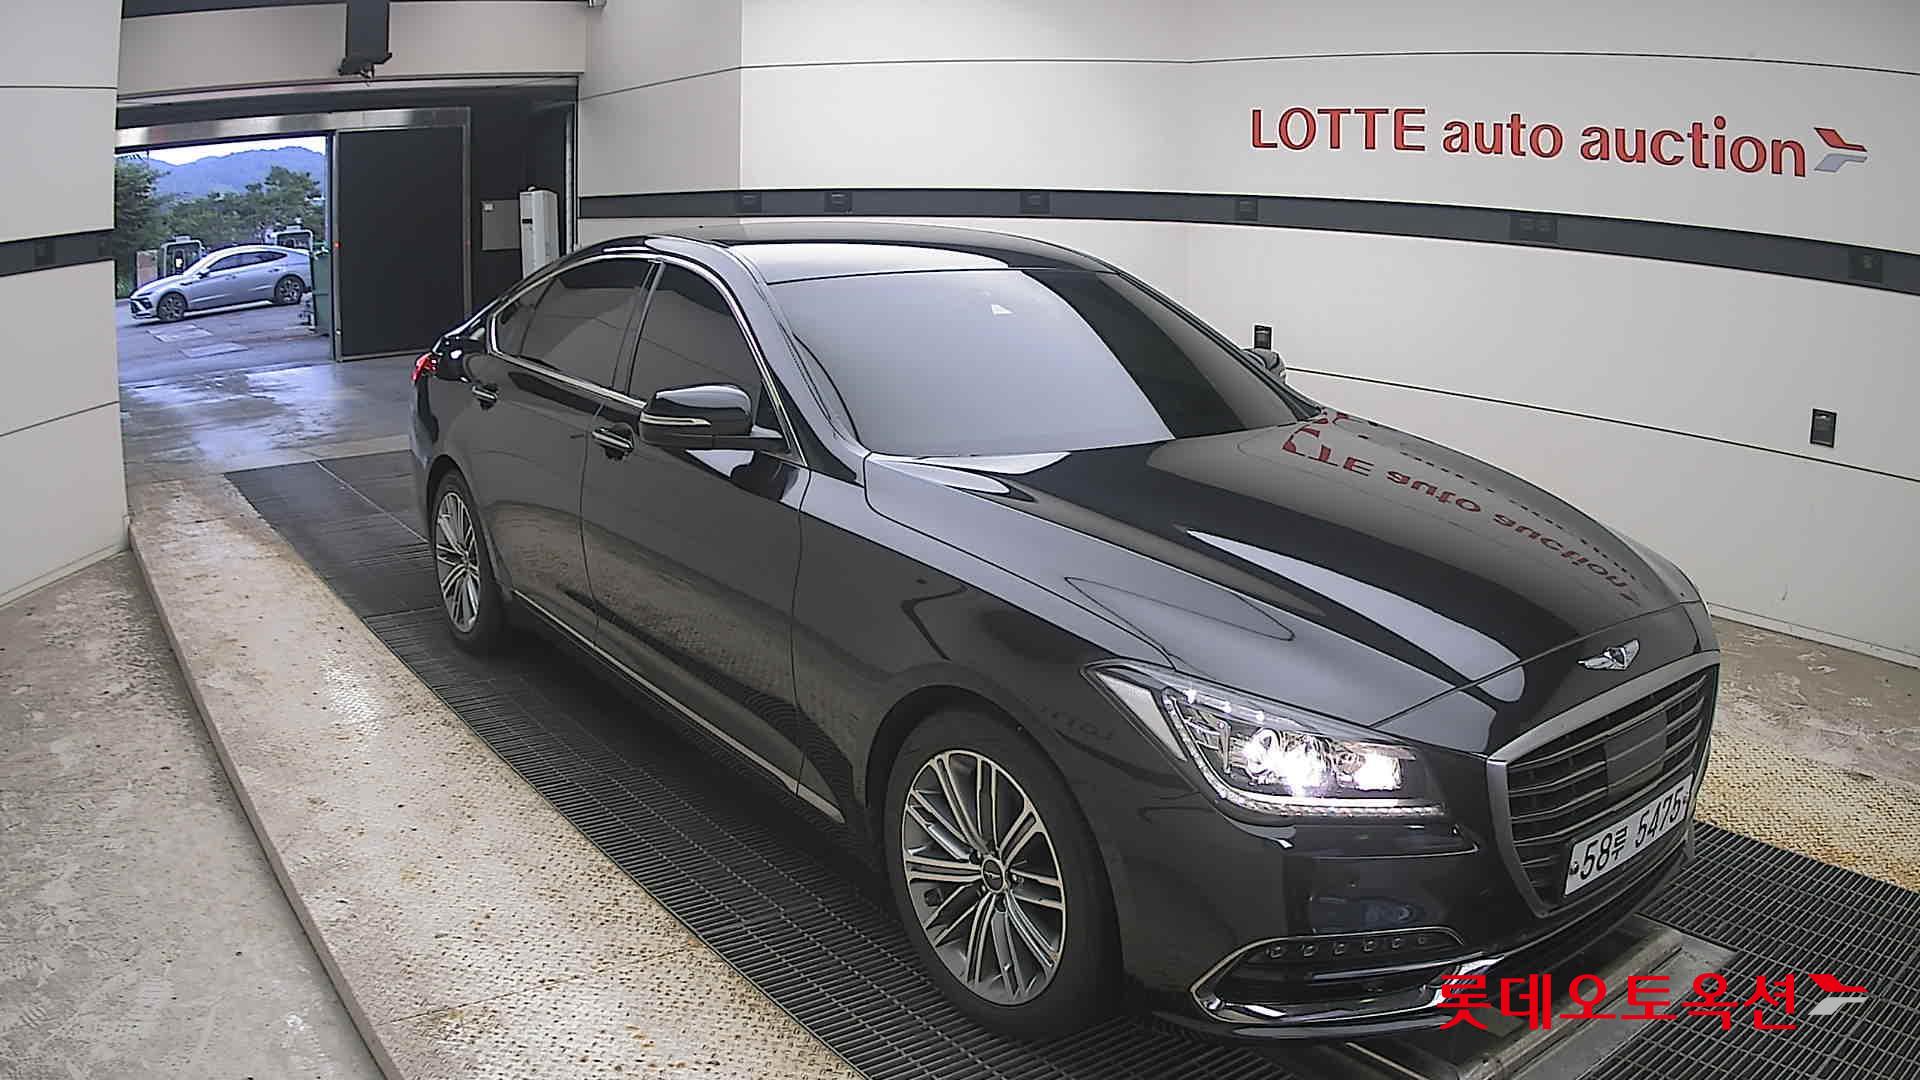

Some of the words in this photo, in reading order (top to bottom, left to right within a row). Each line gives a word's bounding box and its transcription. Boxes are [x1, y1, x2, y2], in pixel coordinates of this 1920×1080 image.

[1252, 107, 1425, 151] LOTTE
[1444, 115, 1564, 157] auto
[1581, 116, 1807, 177] auction
[1580, 826, 1628, 880] 58루
[1635, 786, 1684, 848] 5475
